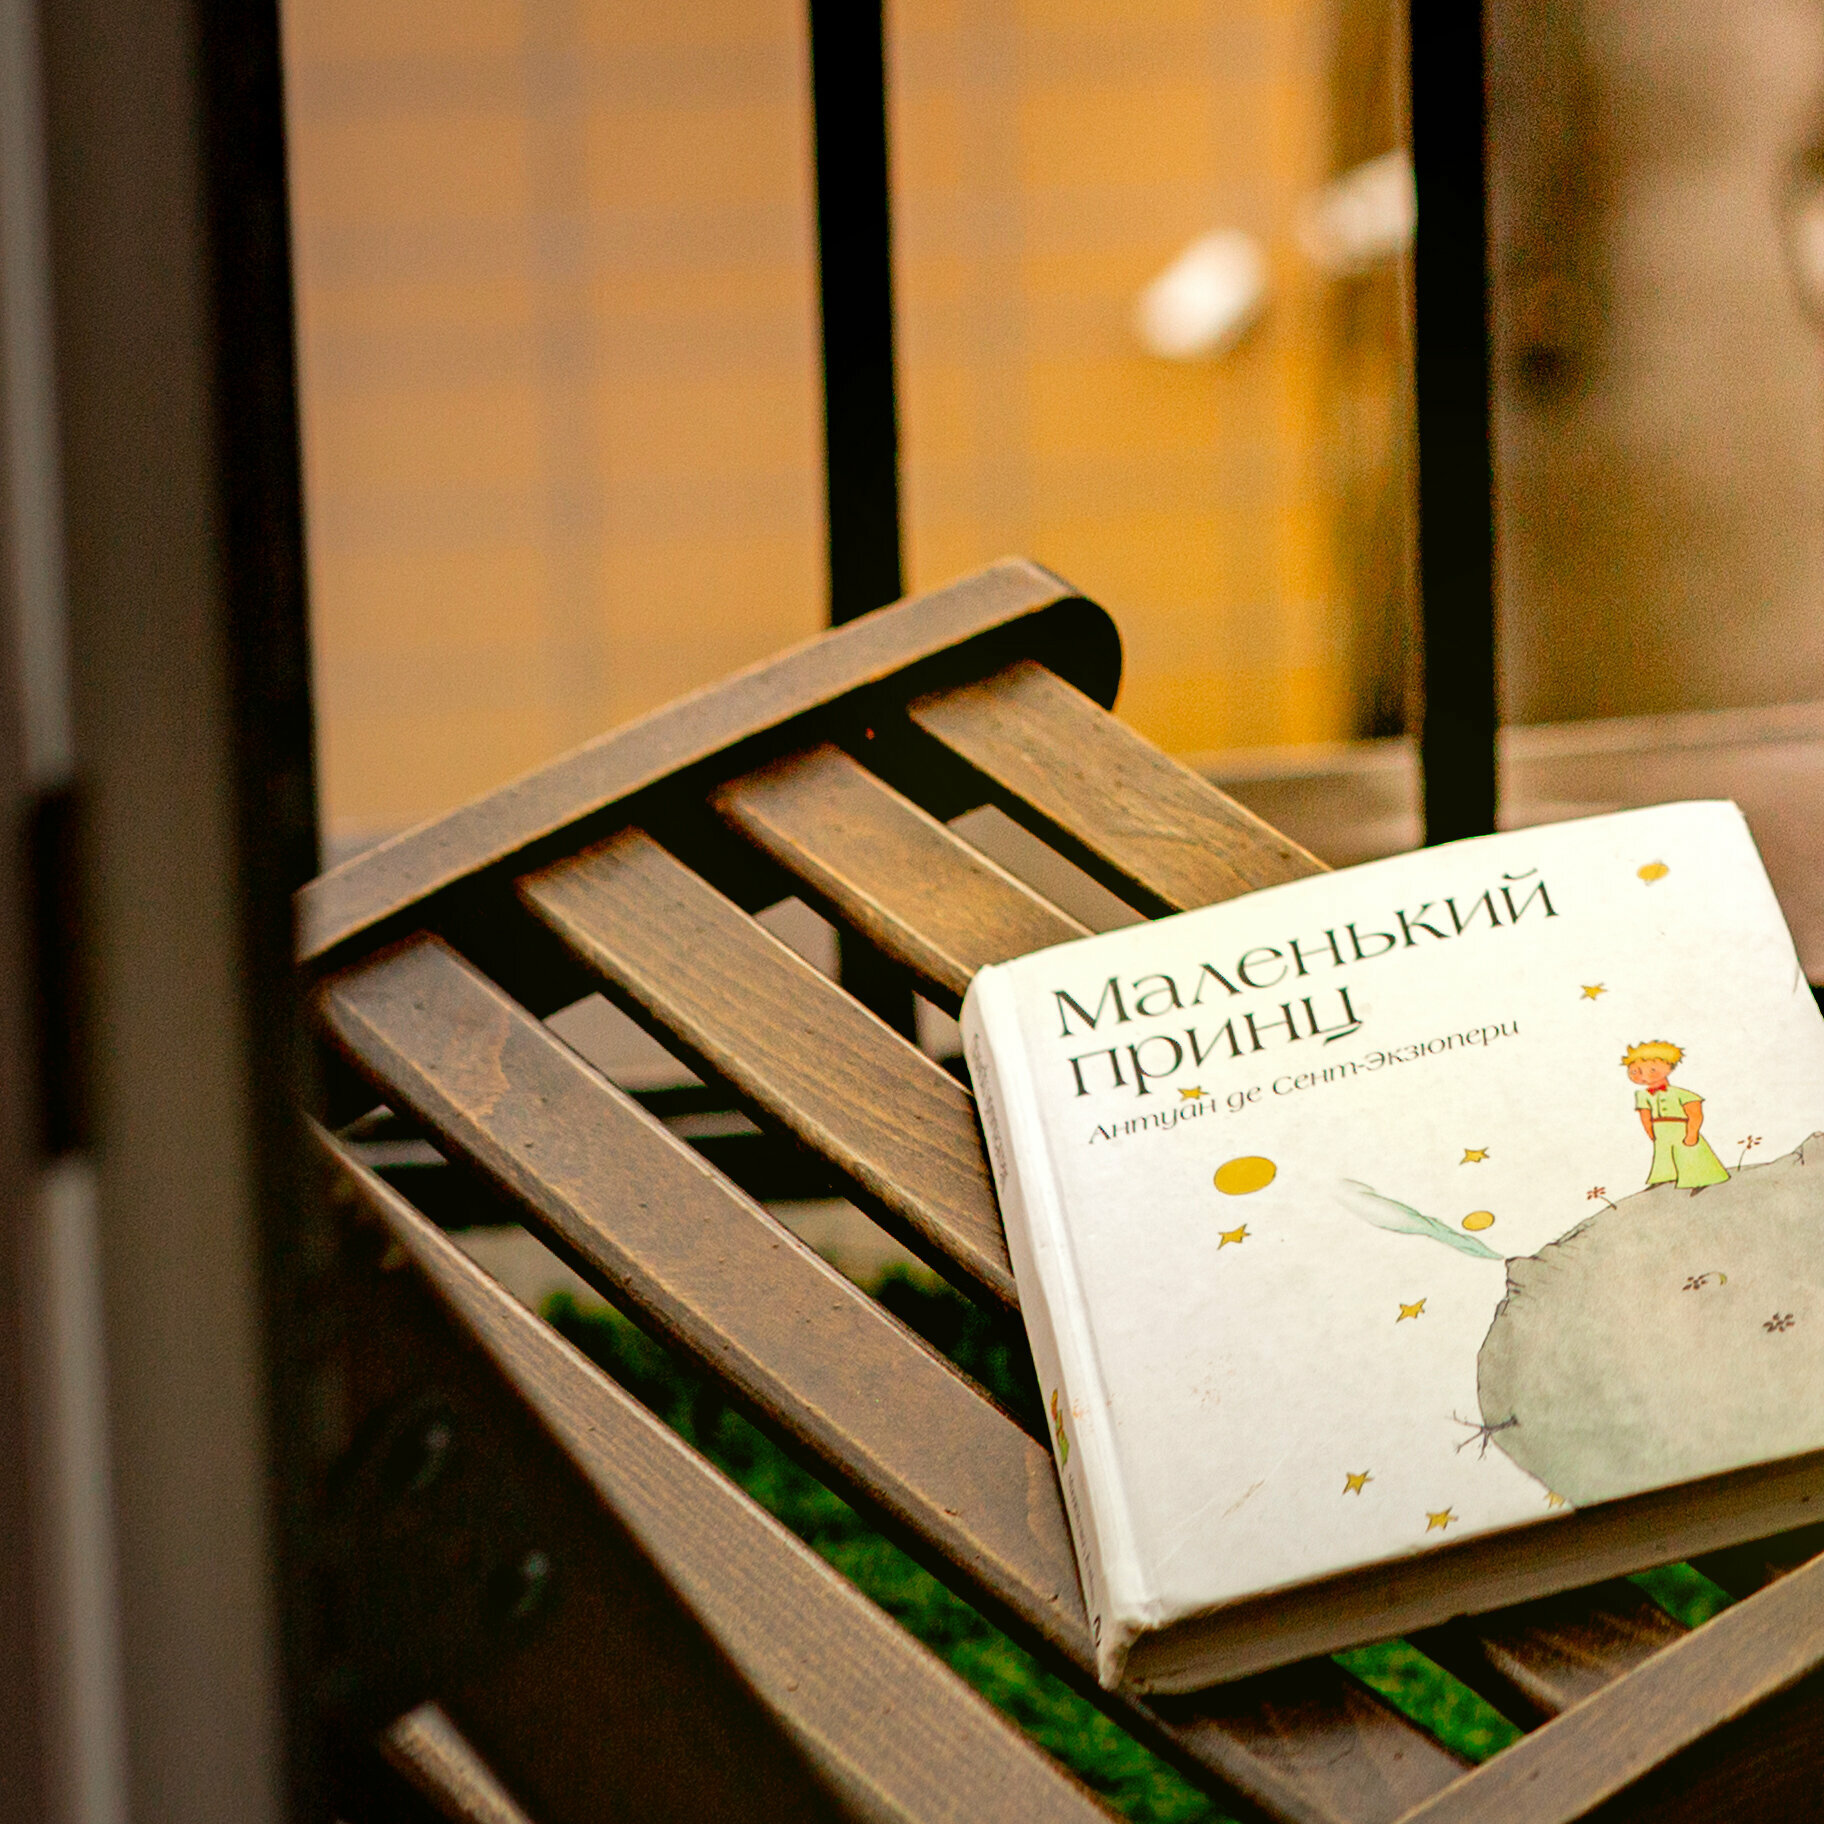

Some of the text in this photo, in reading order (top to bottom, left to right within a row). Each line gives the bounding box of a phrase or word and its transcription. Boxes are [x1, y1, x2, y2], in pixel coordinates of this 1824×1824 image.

[1052, 868, 1559, 1038] Маленький
[1088, 1018, 1520, 1144] Антуан де Сент-Экзюпери
